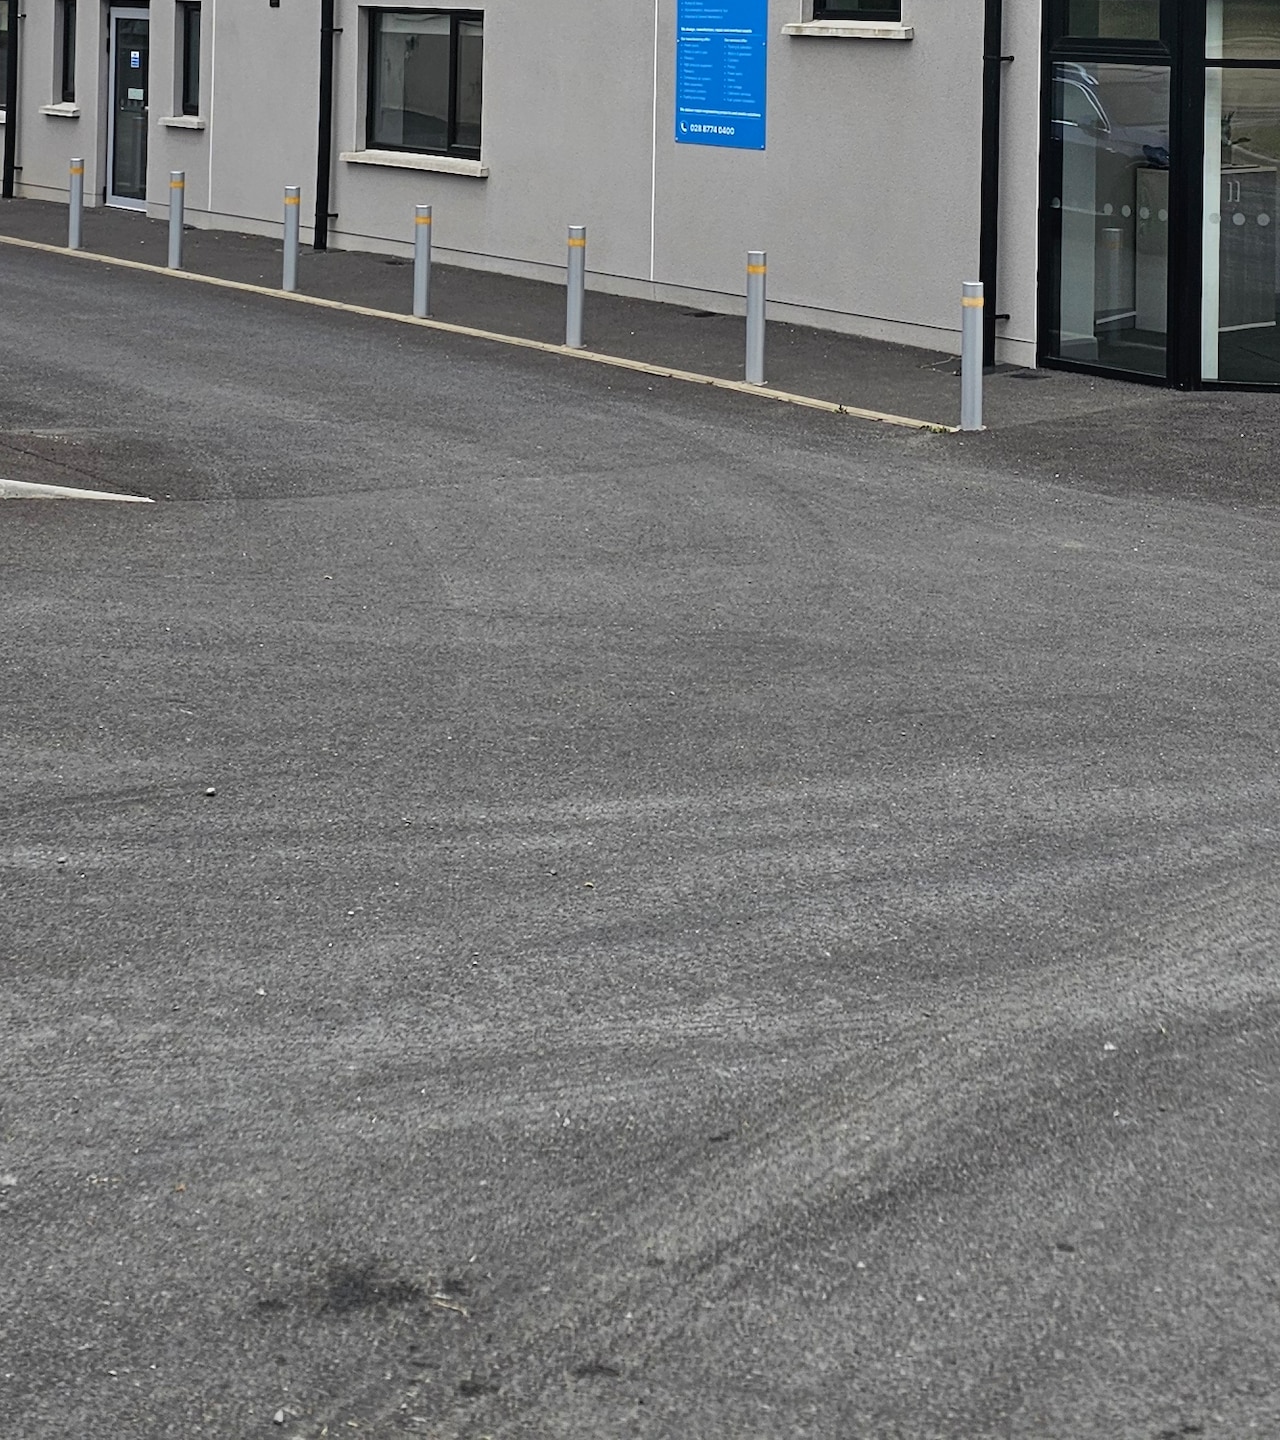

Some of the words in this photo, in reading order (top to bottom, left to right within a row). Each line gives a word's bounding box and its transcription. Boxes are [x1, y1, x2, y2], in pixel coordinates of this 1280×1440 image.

[690, 123, 702, 133] 028
[702, 124, 718, 134] 8774
[718, 126, 735, 136] 0400
